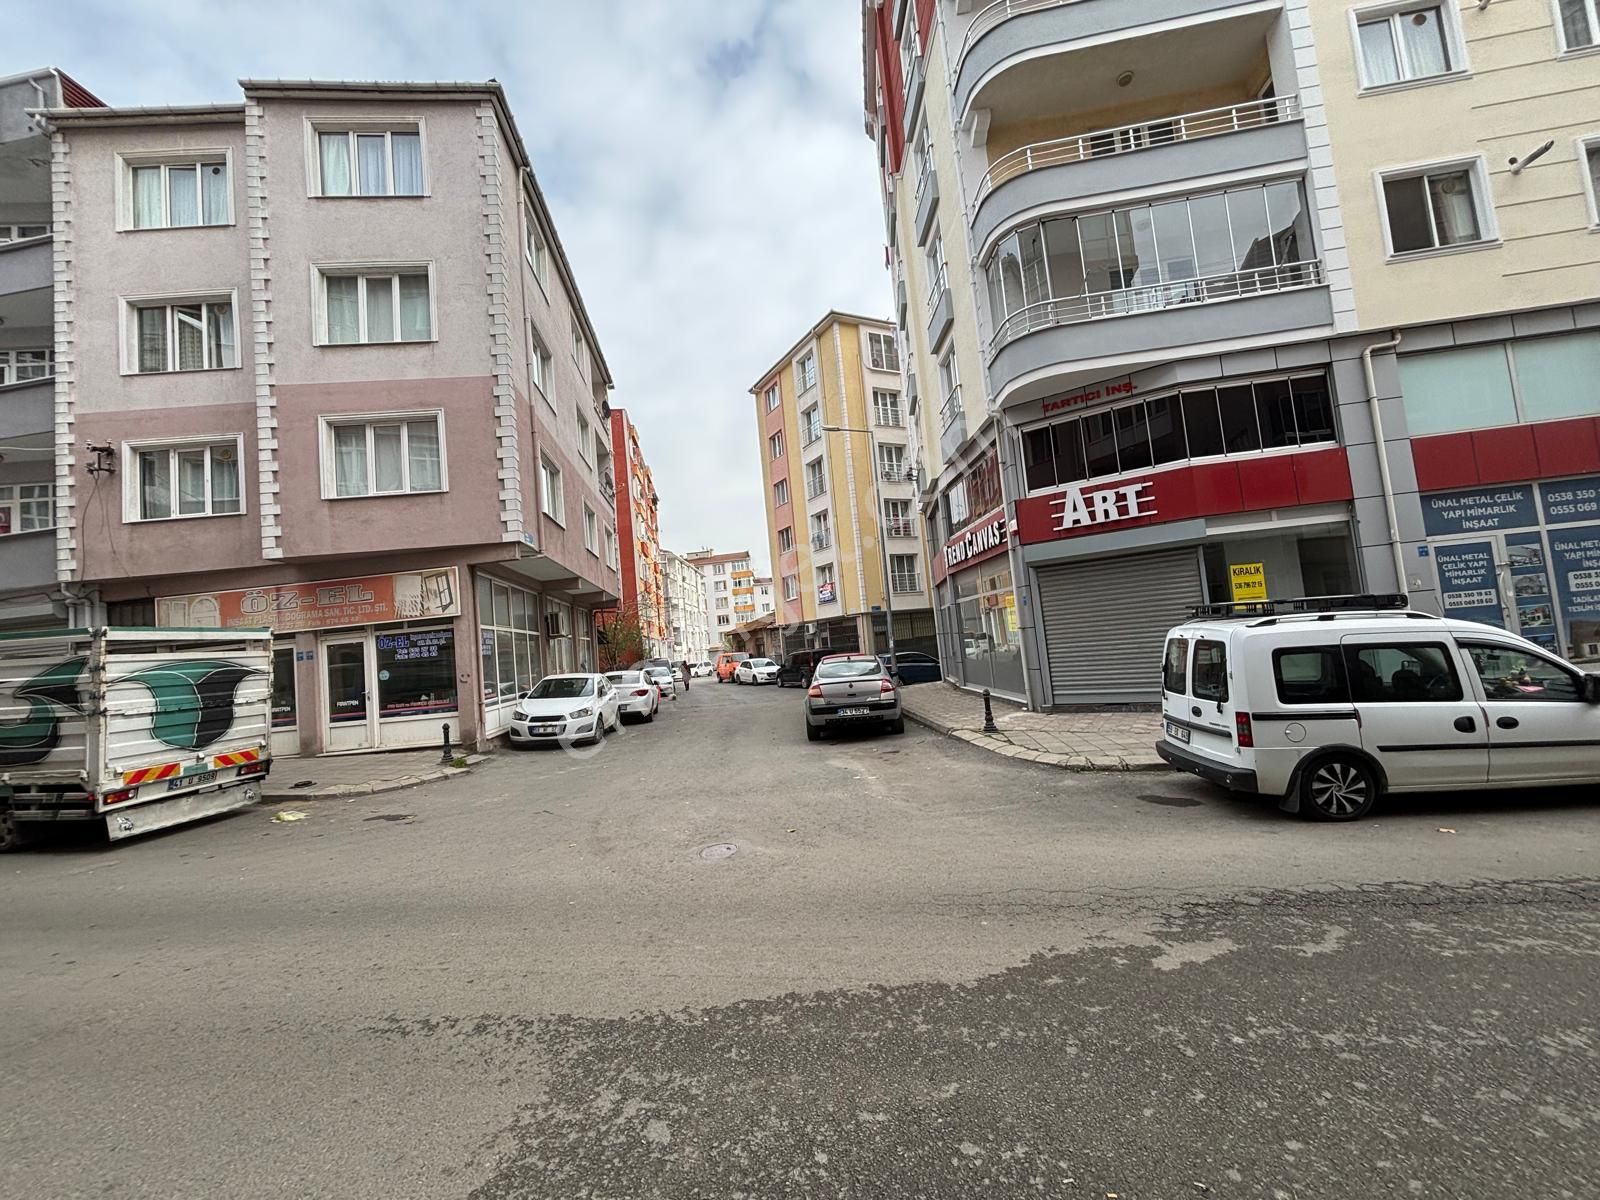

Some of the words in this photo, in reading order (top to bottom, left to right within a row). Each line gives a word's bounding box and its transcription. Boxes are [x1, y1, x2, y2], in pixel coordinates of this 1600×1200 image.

[1042, 390, 1101, 412] TARTICI
[1431, 498, 1459, 508] ÜNAL
[1461, 495, 1493, 505] METAL
[1494, 490, 1524, 503] ÇELİK
[1548, 492, 1573, 502] 0538
[1576, 489, 1596, 499] 350
[1063, 484, 1142, 528] ART
[1442, 510, 1465, 519] YAPI
[1466, 504, 1517, 517] MİMARLIK
[1550, 504, 1576, 515] 0555
[1577, 502, 1597, 512] 069
[1462, 518, 1499, 529] İNŞAAT
[944, 541, 966, 568] TREND
[965, 521, 1000, 559] CANVAS
[1554, 541, 1580, 550] ÜNAL
[1580, 539, 1600, 549] MET
[1437, 554, 1461, 563] ÜNAL
[1461, 552, 1489, 560] METAL
[1564, 550, 1585, 560] YAPI
[1467, 560, 1487, 568] YAPI
[1445, 568, 1487, 578] MİMARLIK
[1573, 572, 1592, 580] 0538
[1452, 576, 1483, 586] İNŞAAT
[1575, 581, 1593, 589] 0555
[240, 584, 375, 615] ÖZ-EL
